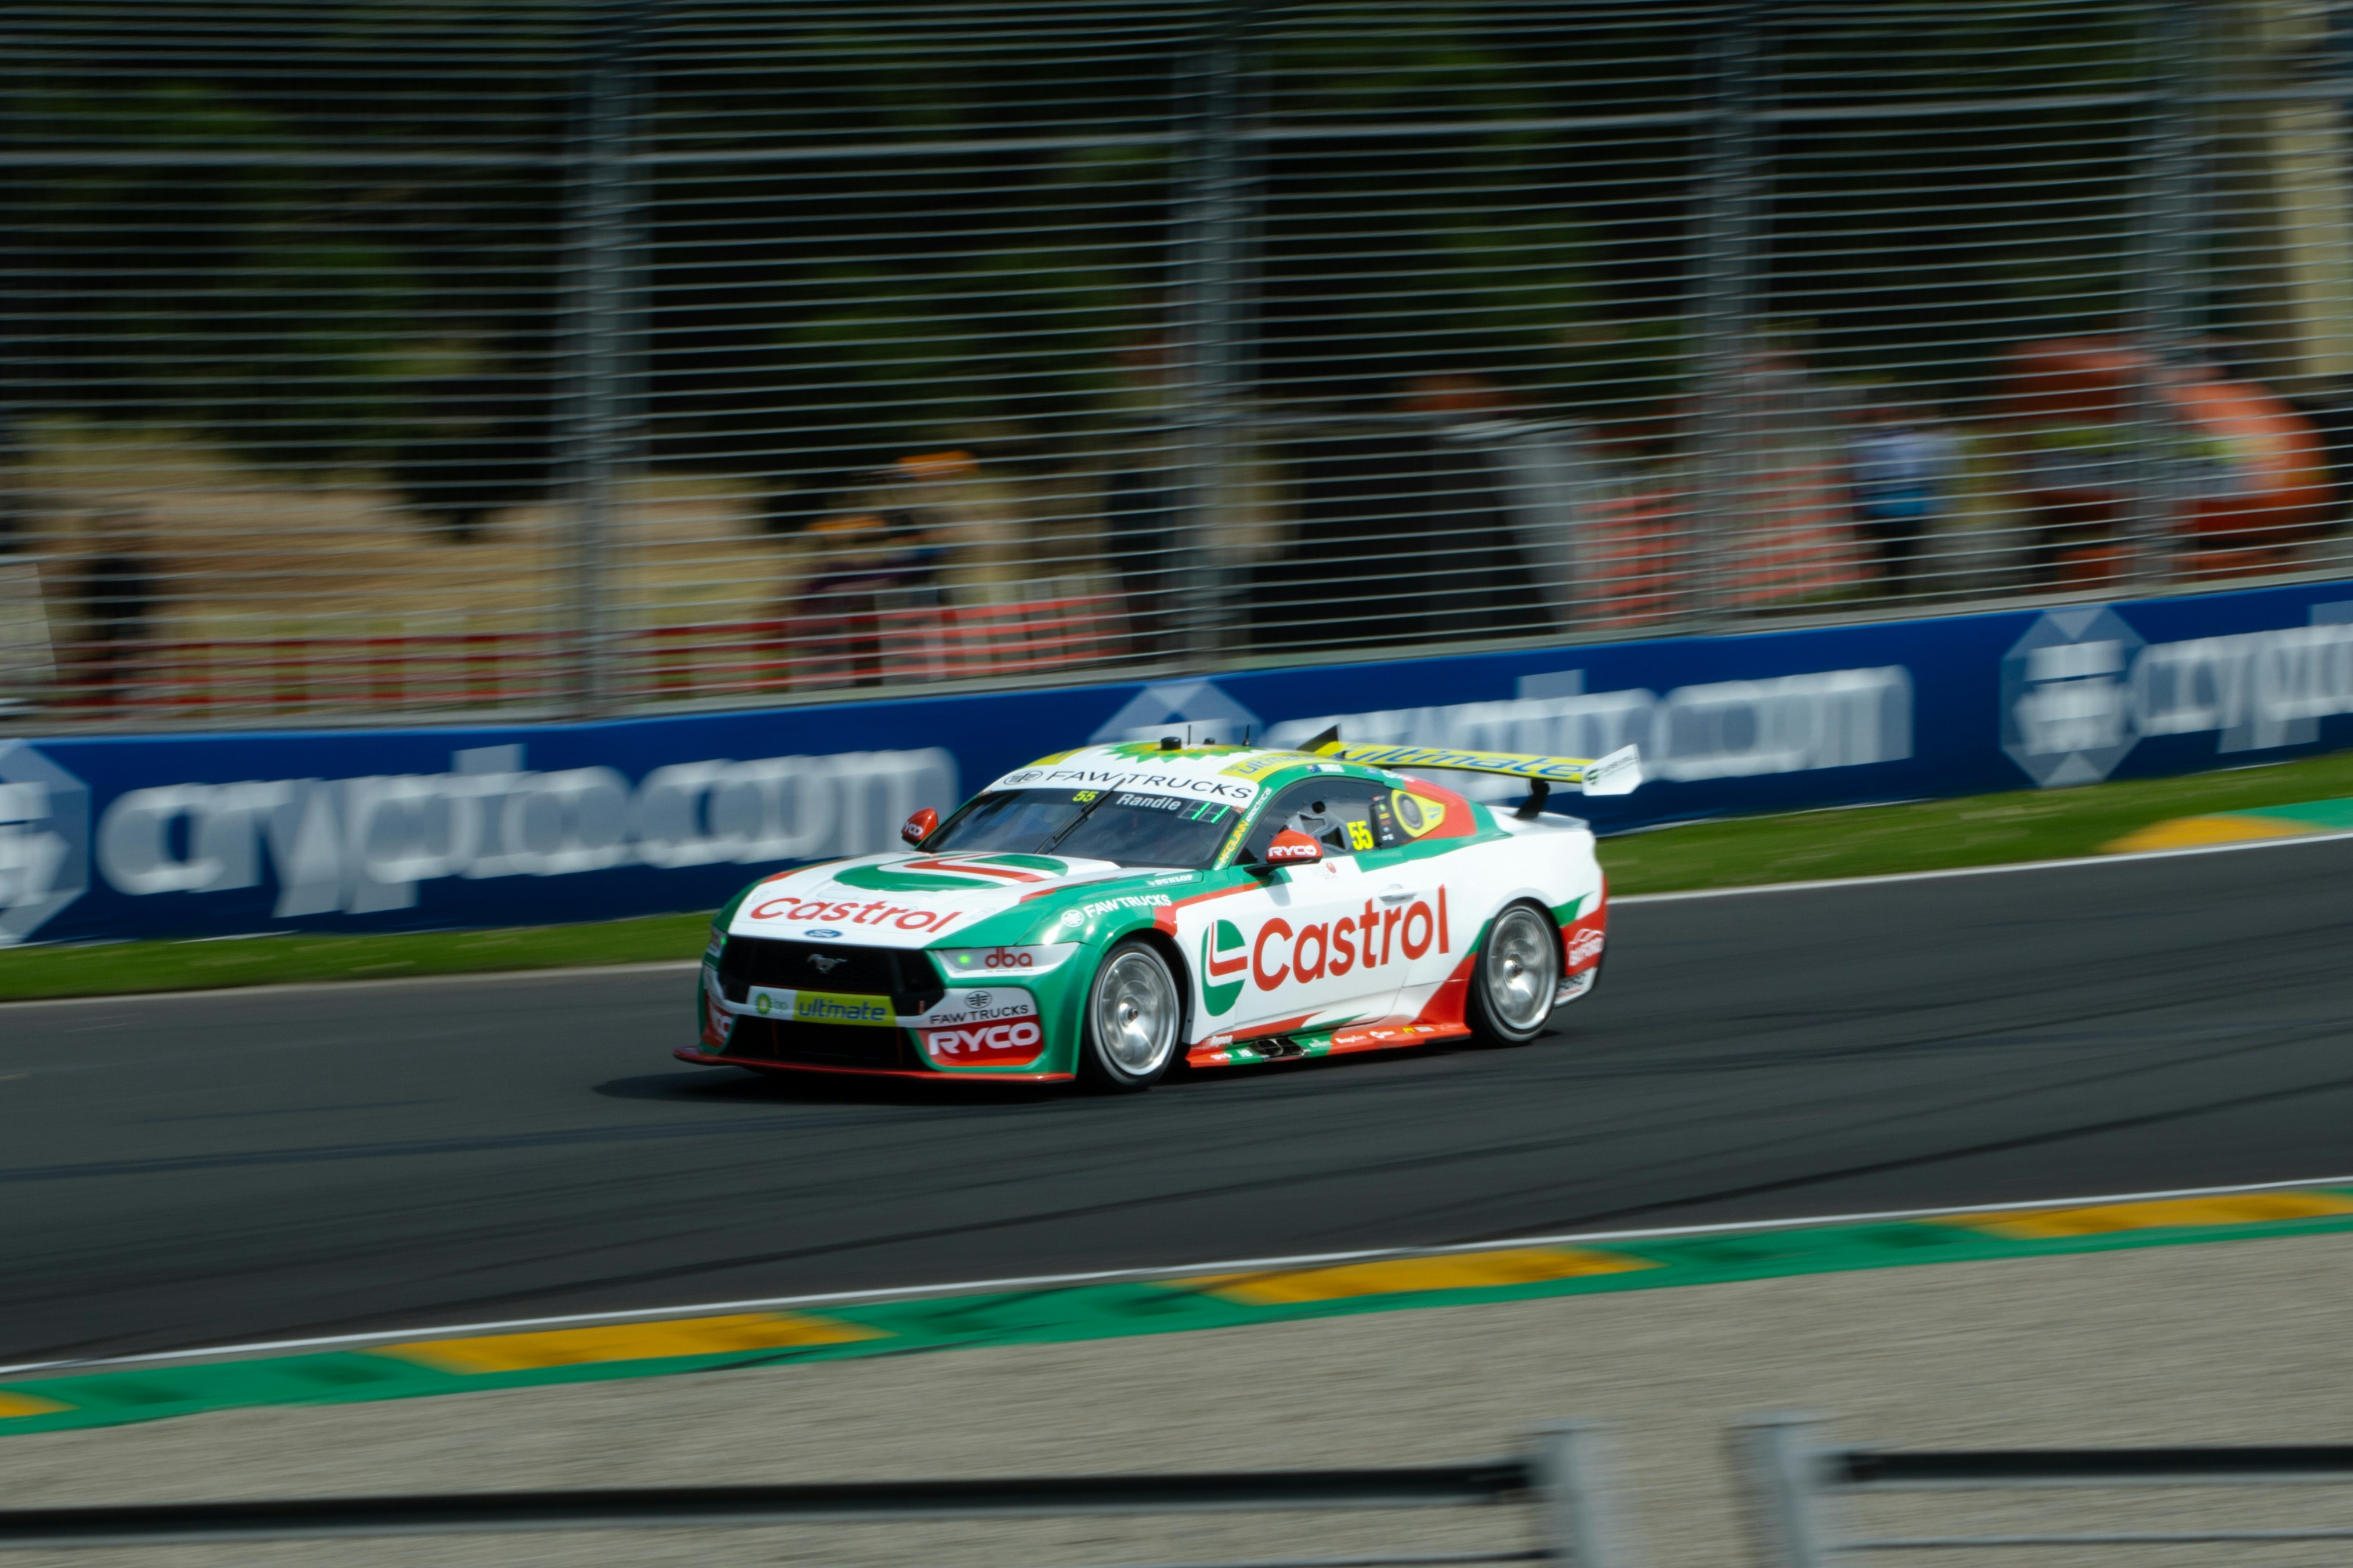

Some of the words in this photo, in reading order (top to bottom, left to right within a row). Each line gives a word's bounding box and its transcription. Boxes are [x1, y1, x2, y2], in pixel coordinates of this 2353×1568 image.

[1046, 770, 1125, 783] FAW
[1126, 773, 1253, 799] TRUCKS
[1072, 790, 1099, 803] 55
[1115, 792, 1182, 811] Randle
[1245, 786, 1273, 823] electrical
[96, 743, 960, 918] crypto.com
[1347, 820, 1375, 851] 55
[1268, 844, 1317, 857] RYCO
[1155, 875, 1194, 885] DUNLOP
[750, 897, 964, 933] Castrol
[1083, 899, 1120, 918] FAW
[1116, 894, 1172, 907] TRUCKS
[1252, 883, 1450, 992] Castrol
[984, 947, 1033, 968] dba
[798, 998, 887, 1022] ultimate
[930, 1013, 967, 1025] FAW
[969, 1005, 1029, 1021] TRUCKS
[928, 1022, 1041, 1056] RYCO
